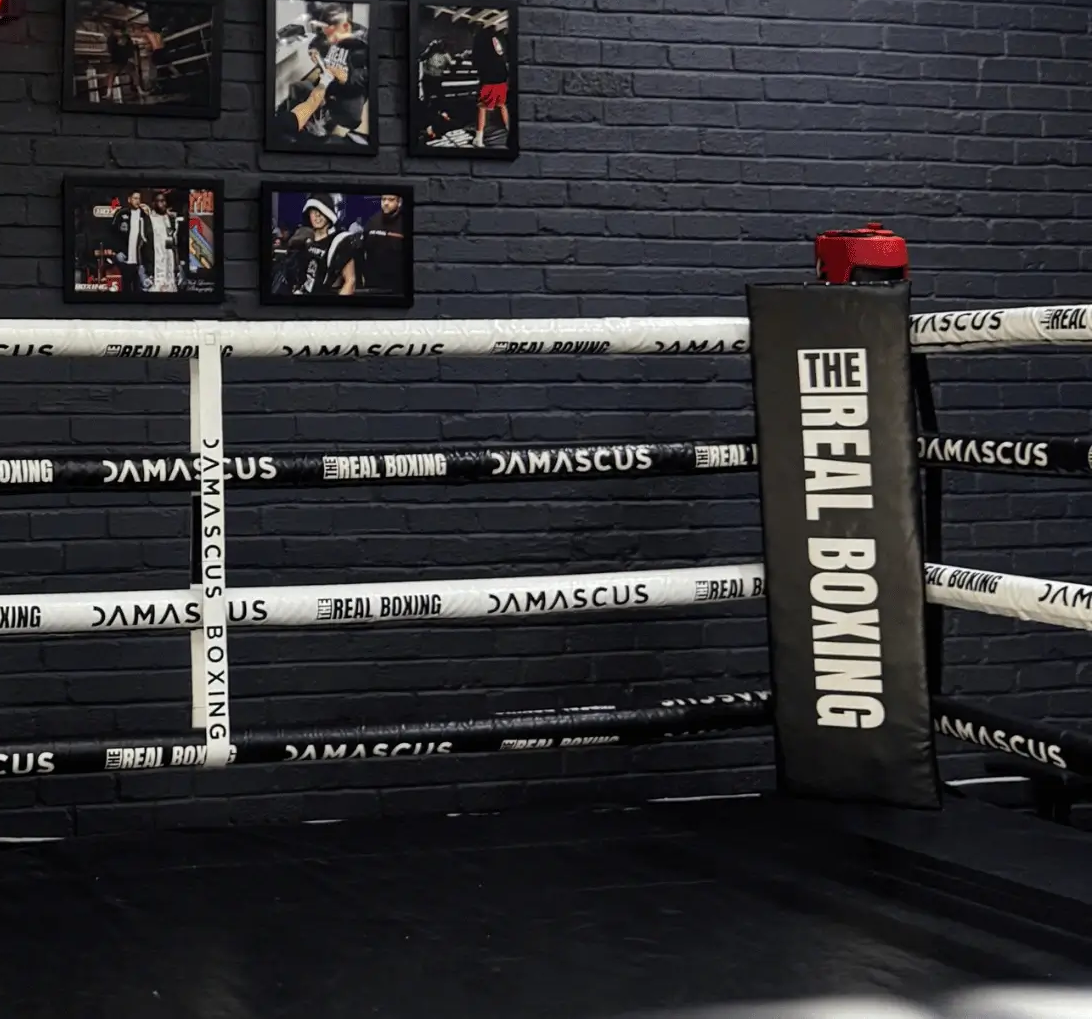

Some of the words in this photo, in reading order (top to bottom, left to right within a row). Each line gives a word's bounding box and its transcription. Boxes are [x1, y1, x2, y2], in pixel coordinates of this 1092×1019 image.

[803, 352, 862, 388] THE
[338, 456, 381, 479] REAL
[384, 453, 447, 477] BOXING
[491, 448, 652, 475] DAMASCUS
[709, 444, 748, 467] REAL
[800, 394, 874, 521] REAL
[203, 439, 223, 599] DAMASCUS
[91, 600, 268, 627] DAMASUS
[332, 597, 374, 619] REAL
[380, 594, 442, 617] BOXING
[487, 584, 649, 614] DAMASCUS
[708, 578, 746, 600] REAL
[947, 569, 1003, 594] BOXING
[807, 537, 886, 729] BOXING
[206, 625, 227, 741] BOXING
[121, 746, 165, 769] REAL
[170, 744, 238, 766] BOXG
